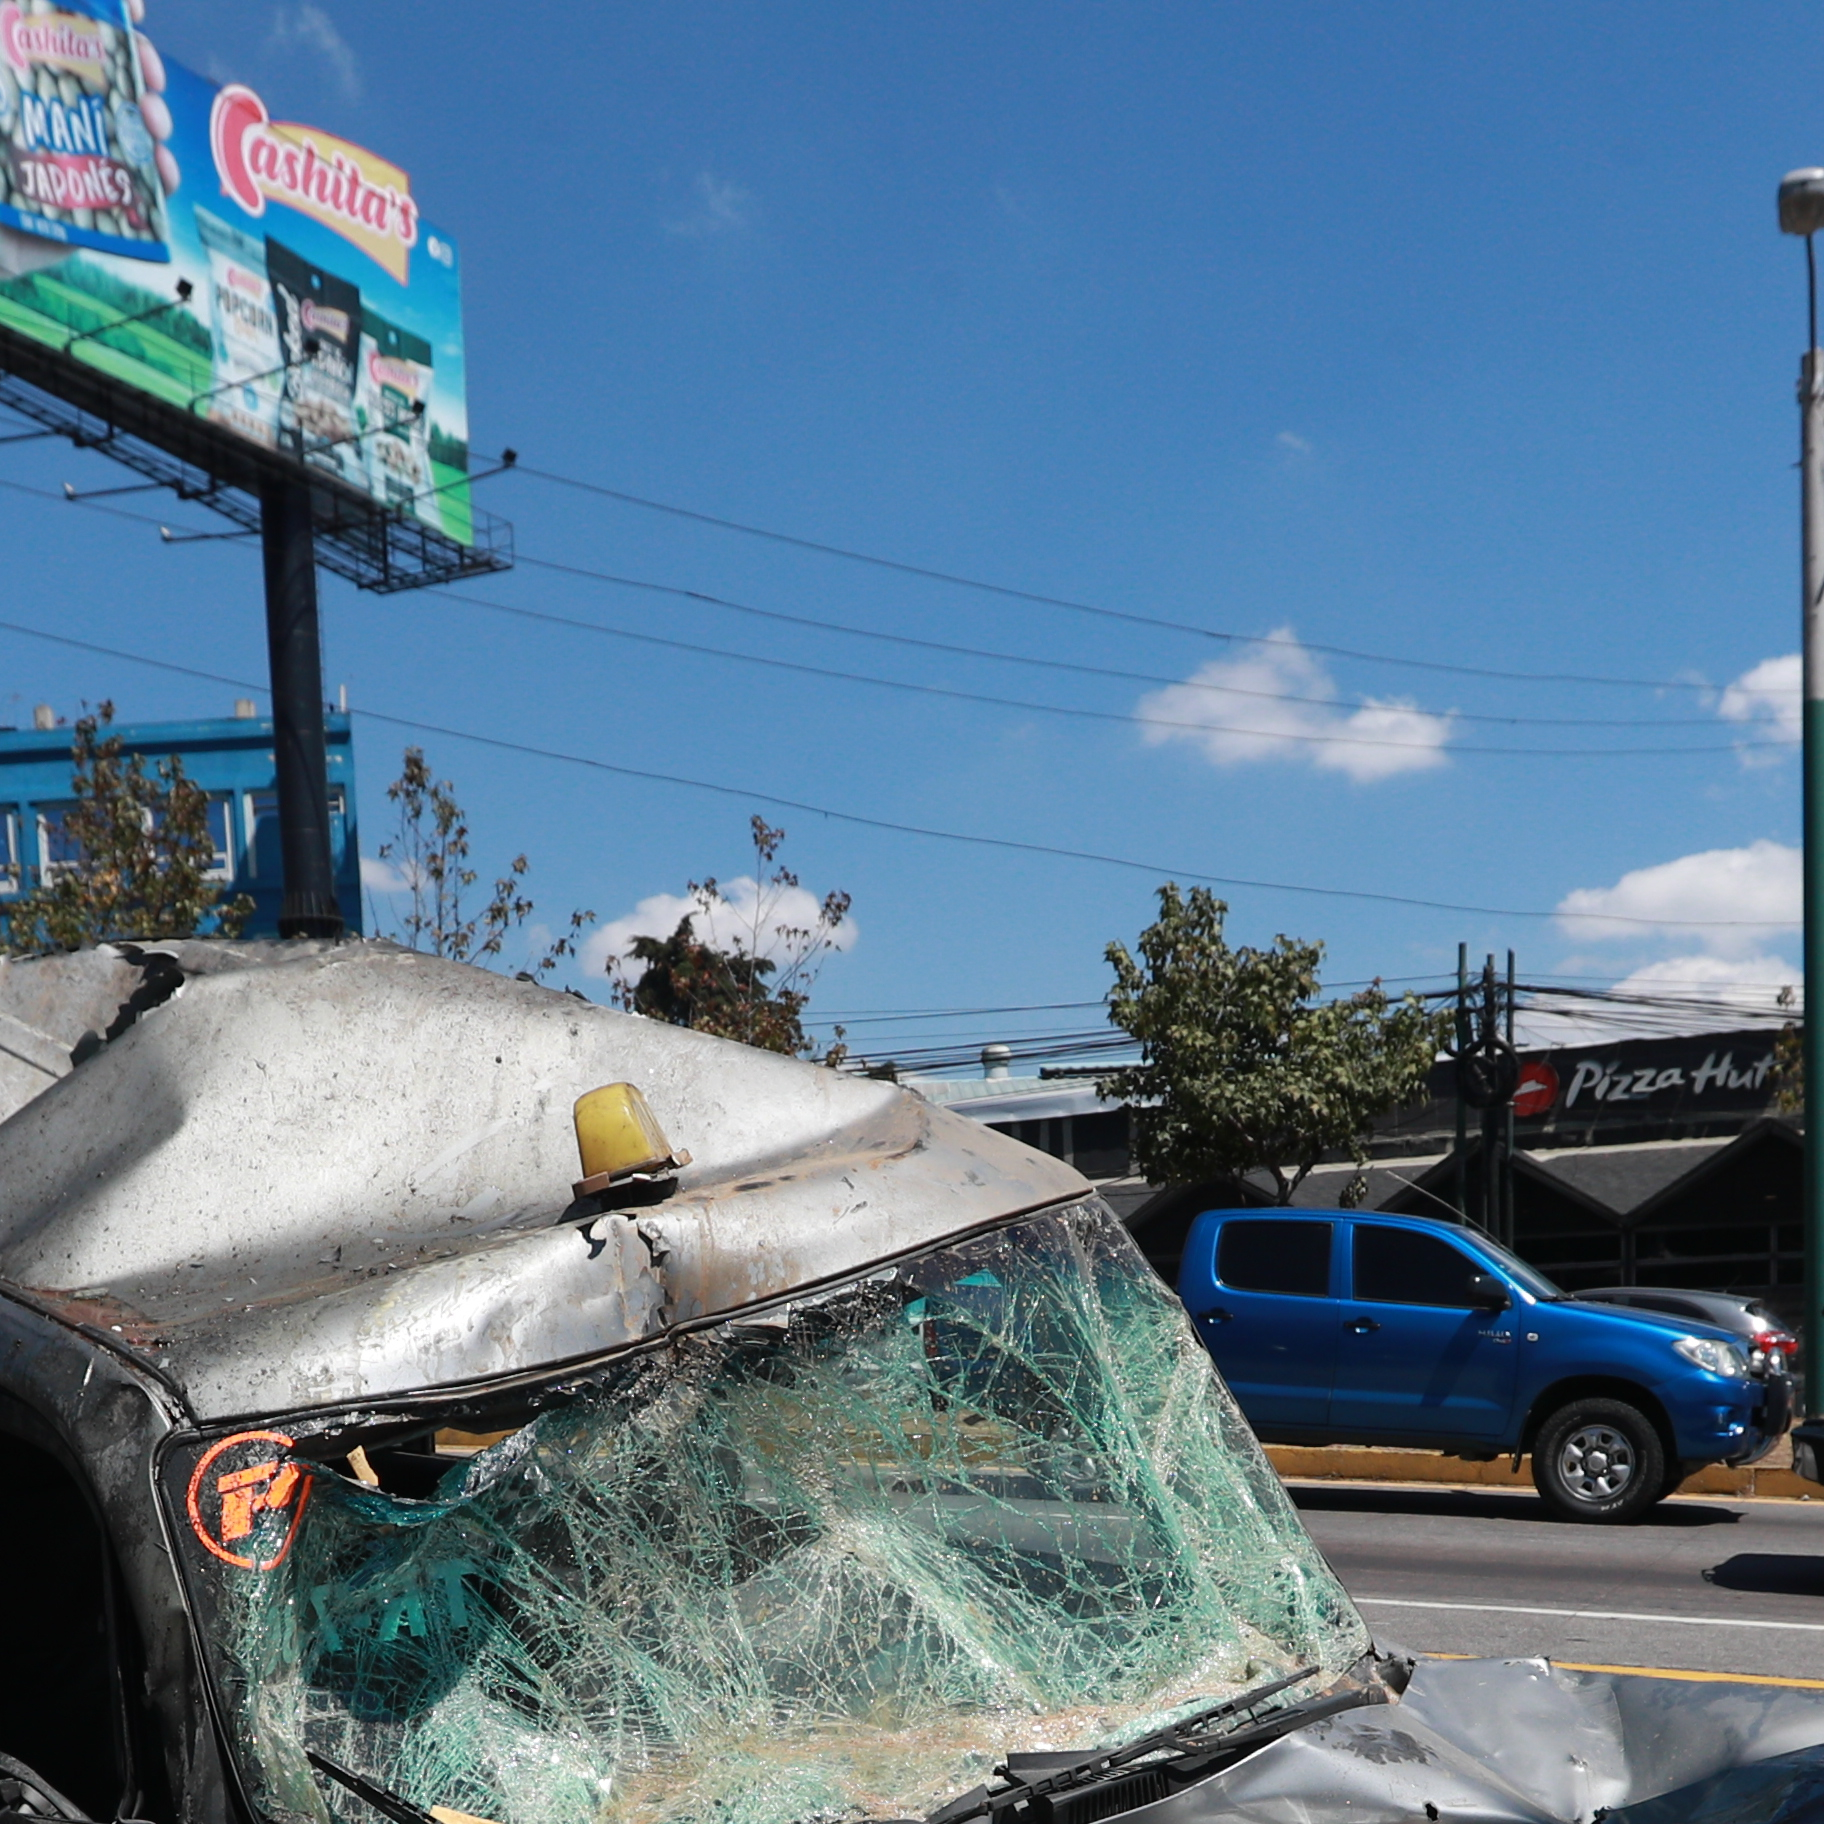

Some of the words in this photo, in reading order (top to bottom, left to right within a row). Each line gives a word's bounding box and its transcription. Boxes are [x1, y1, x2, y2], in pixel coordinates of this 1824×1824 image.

[22, 92, 109, 157] MANÍ
[20, 158, 133, 205] JAPONÉS
[212, 86, 417, 246] Cashita's
[216, 283, 274, 336] POPCORN
[1566, 1060, 1686, 1109] Pizza
[1690, 1051, 1781, 1095] Hut
